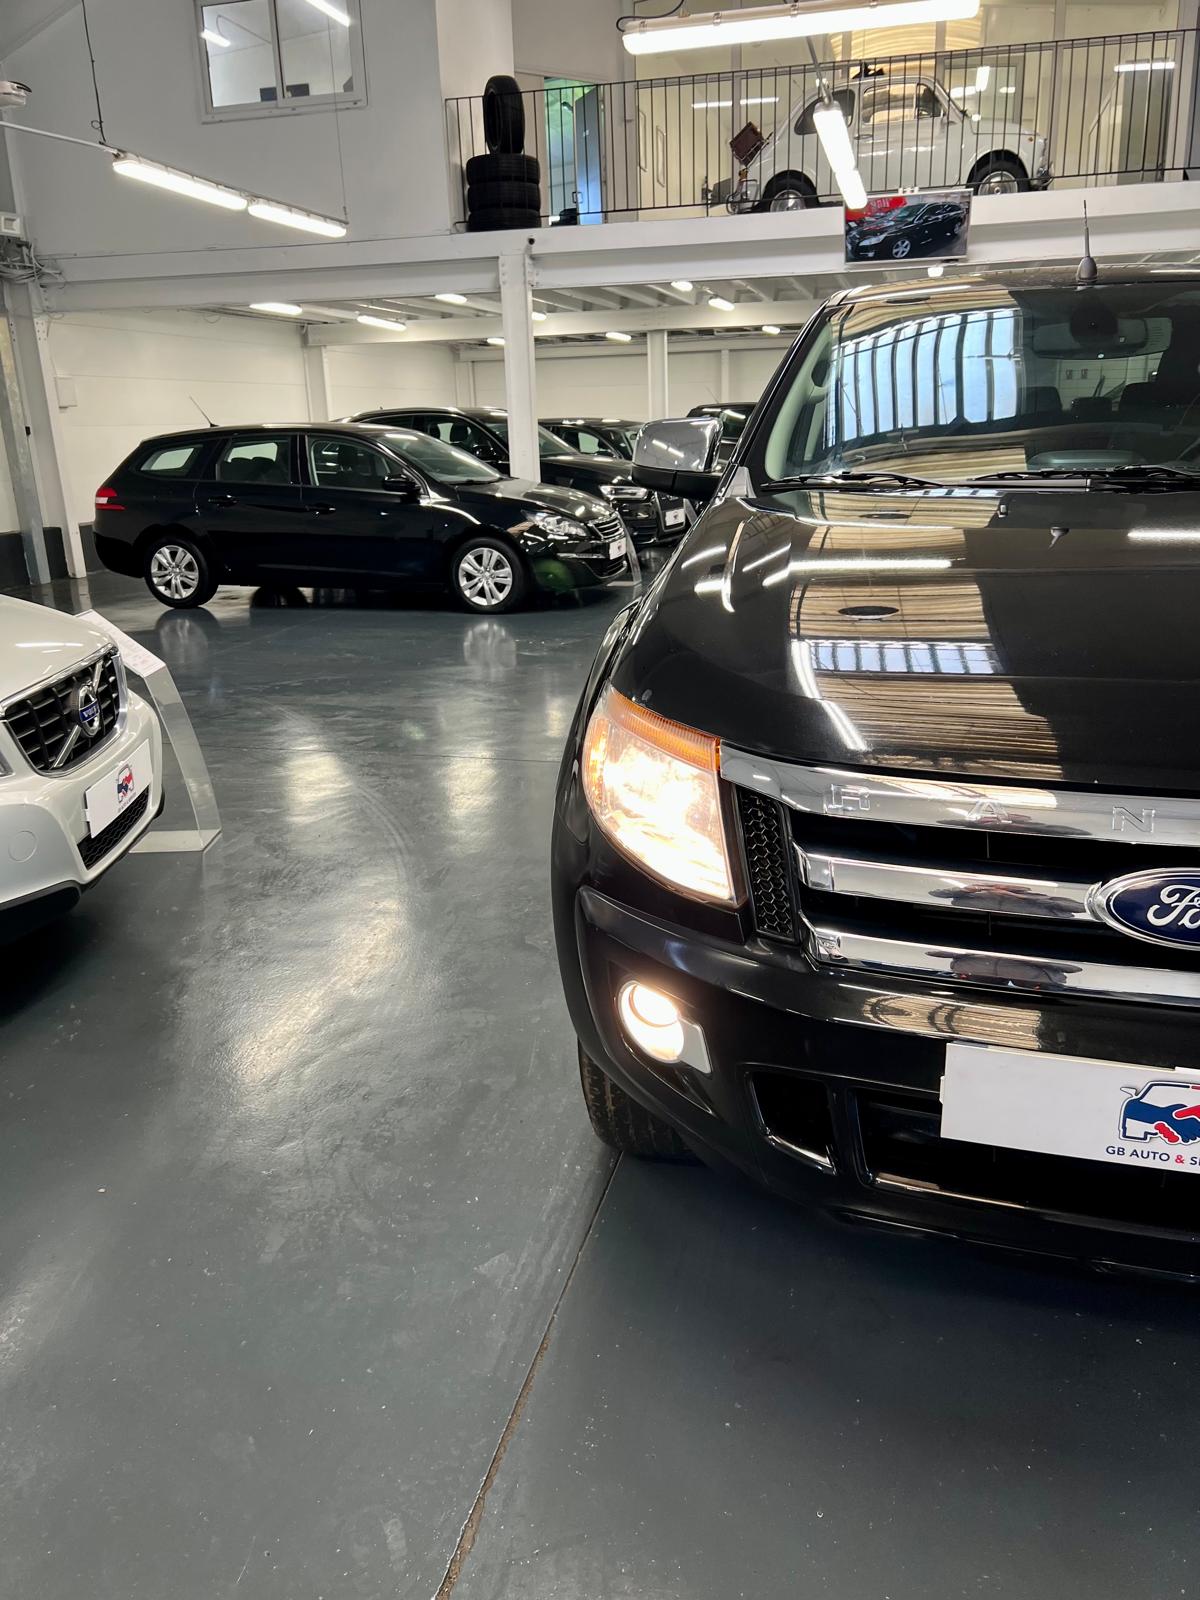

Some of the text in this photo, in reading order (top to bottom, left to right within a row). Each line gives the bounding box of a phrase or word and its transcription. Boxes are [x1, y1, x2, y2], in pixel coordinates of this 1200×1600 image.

[1106, 1145, 1200, 1166] GB AUTO & S
